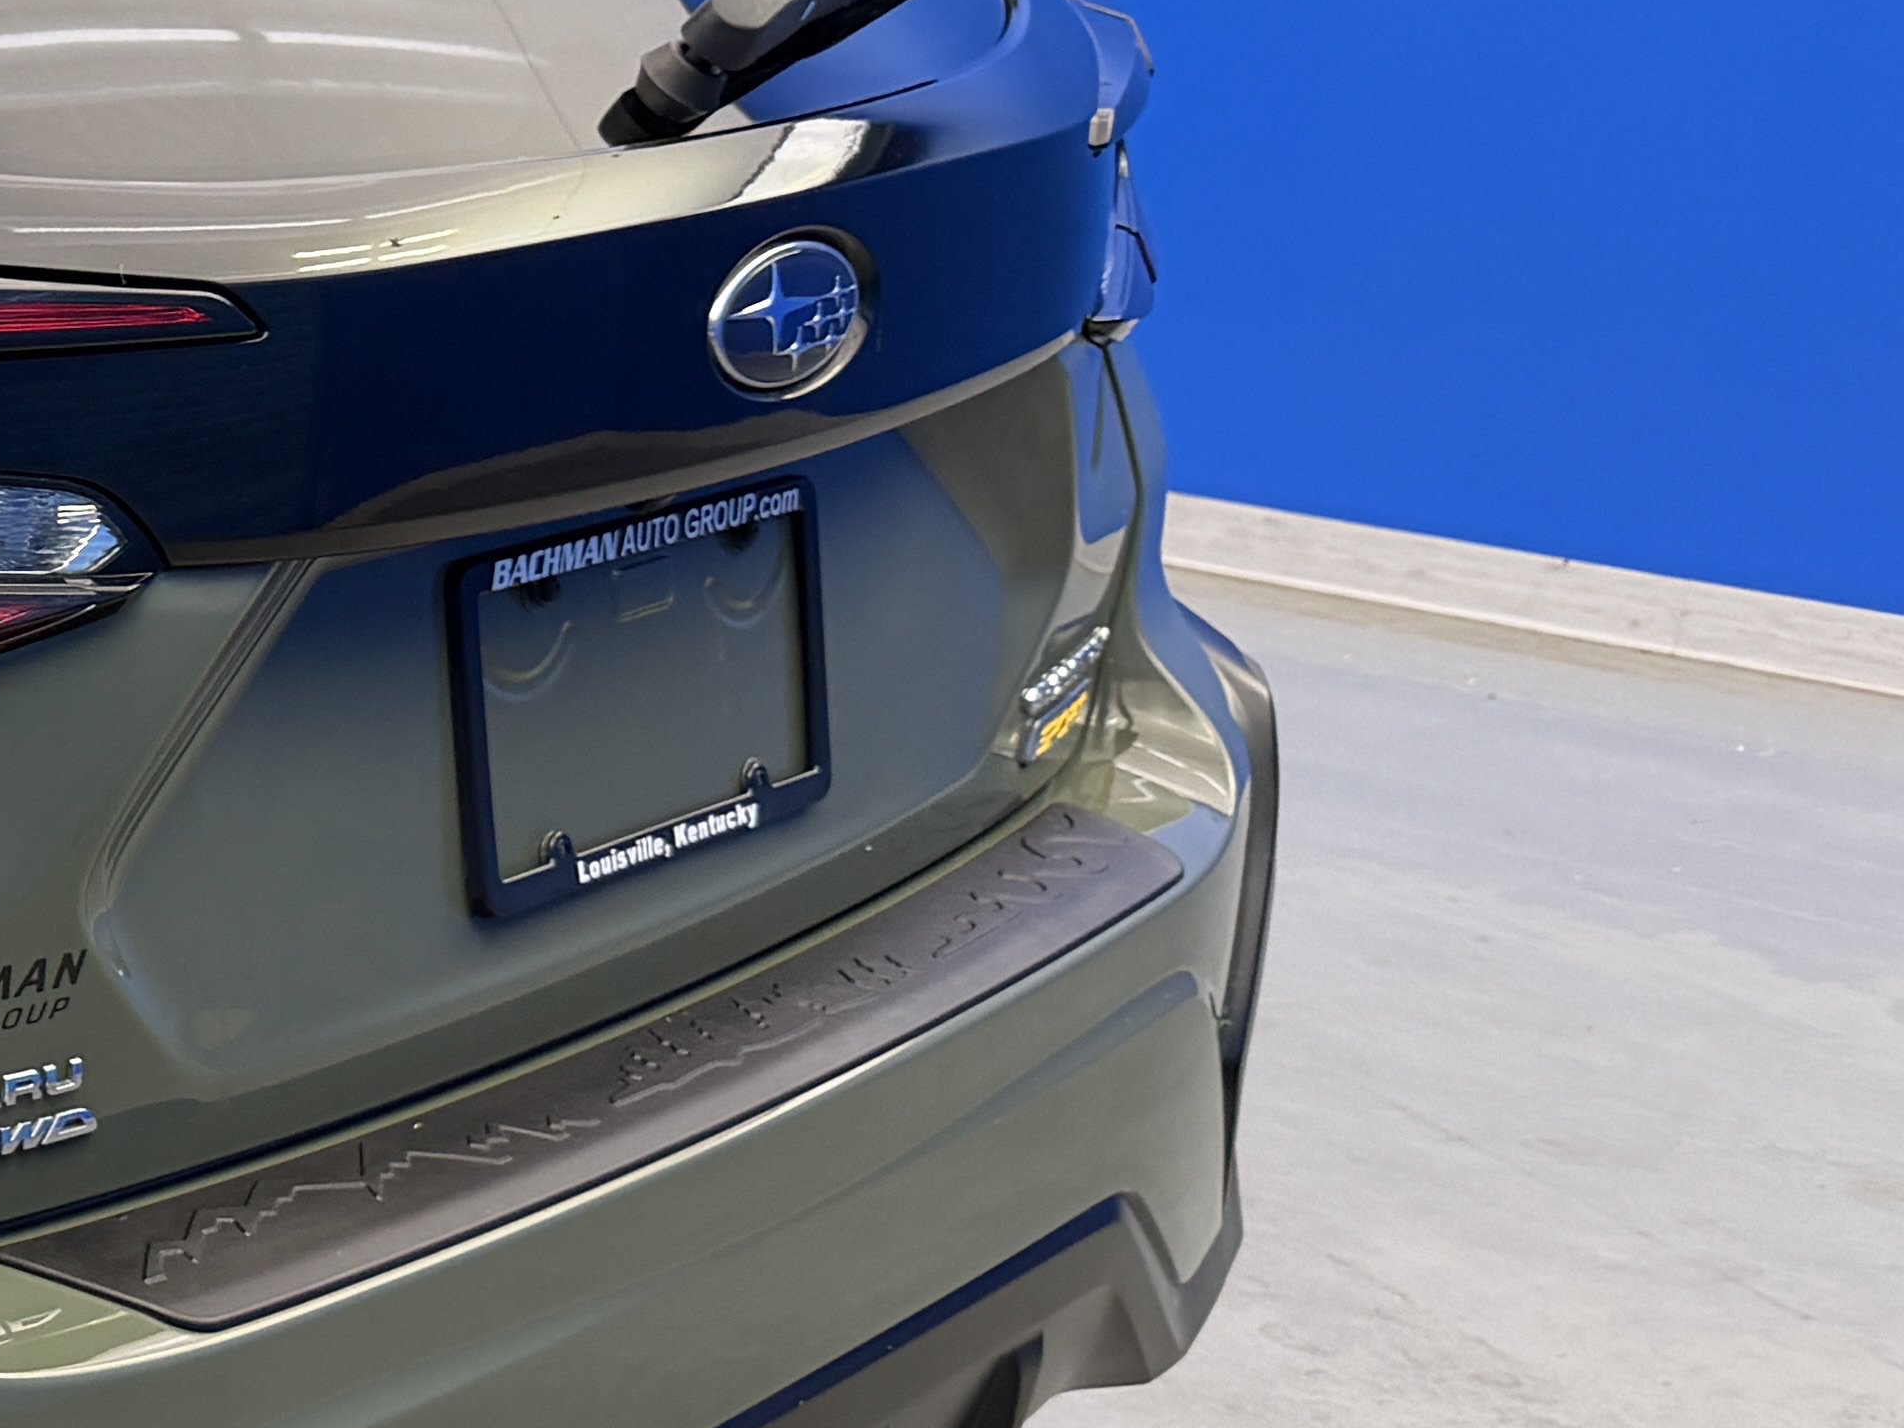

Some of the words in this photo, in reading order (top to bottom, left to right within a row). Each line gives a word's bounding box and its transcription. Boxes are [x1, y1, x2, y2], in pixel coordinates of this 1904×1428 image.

[492, 529, 621, 592] BACHMAN
[621, 513, 680, 557] AUTO
[683, 488, 801, 540] GROUP.com
[576, 832, 673, 884] Louisville,
[674, 800, 760, 850] Kentucky
